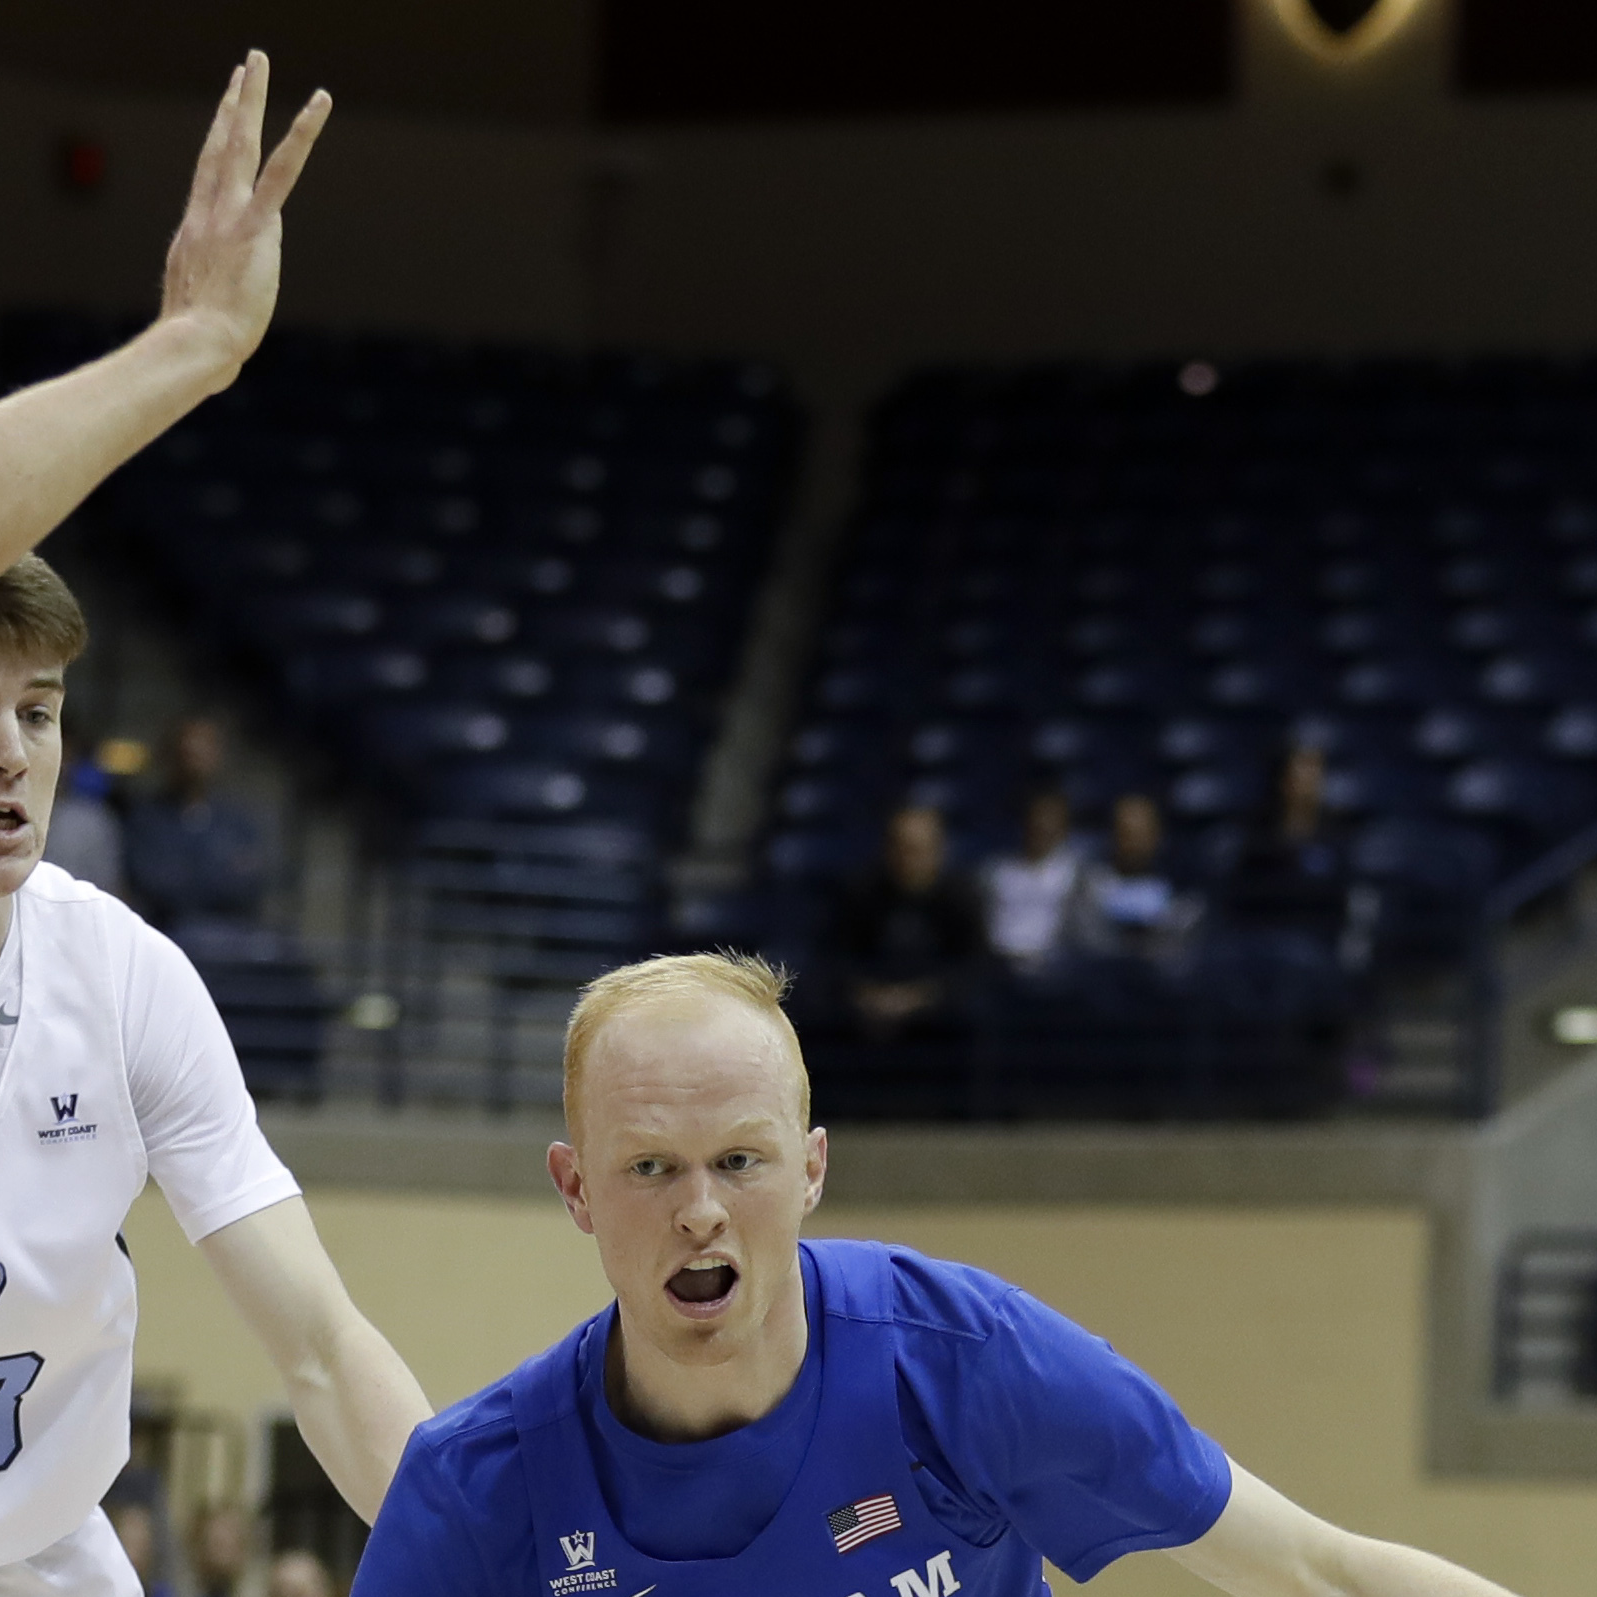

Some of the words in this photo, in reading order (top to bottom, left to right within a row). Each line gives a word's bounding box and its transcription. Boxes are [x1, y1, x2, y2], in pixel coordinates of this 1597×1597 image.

[37, 1128, 66, 1139] WEST
[549, 1573, 584, 1589] WEST
[585, 1568, 616, 1582] COAST
[553, 1580, 618, 1597] CONFERENCE
